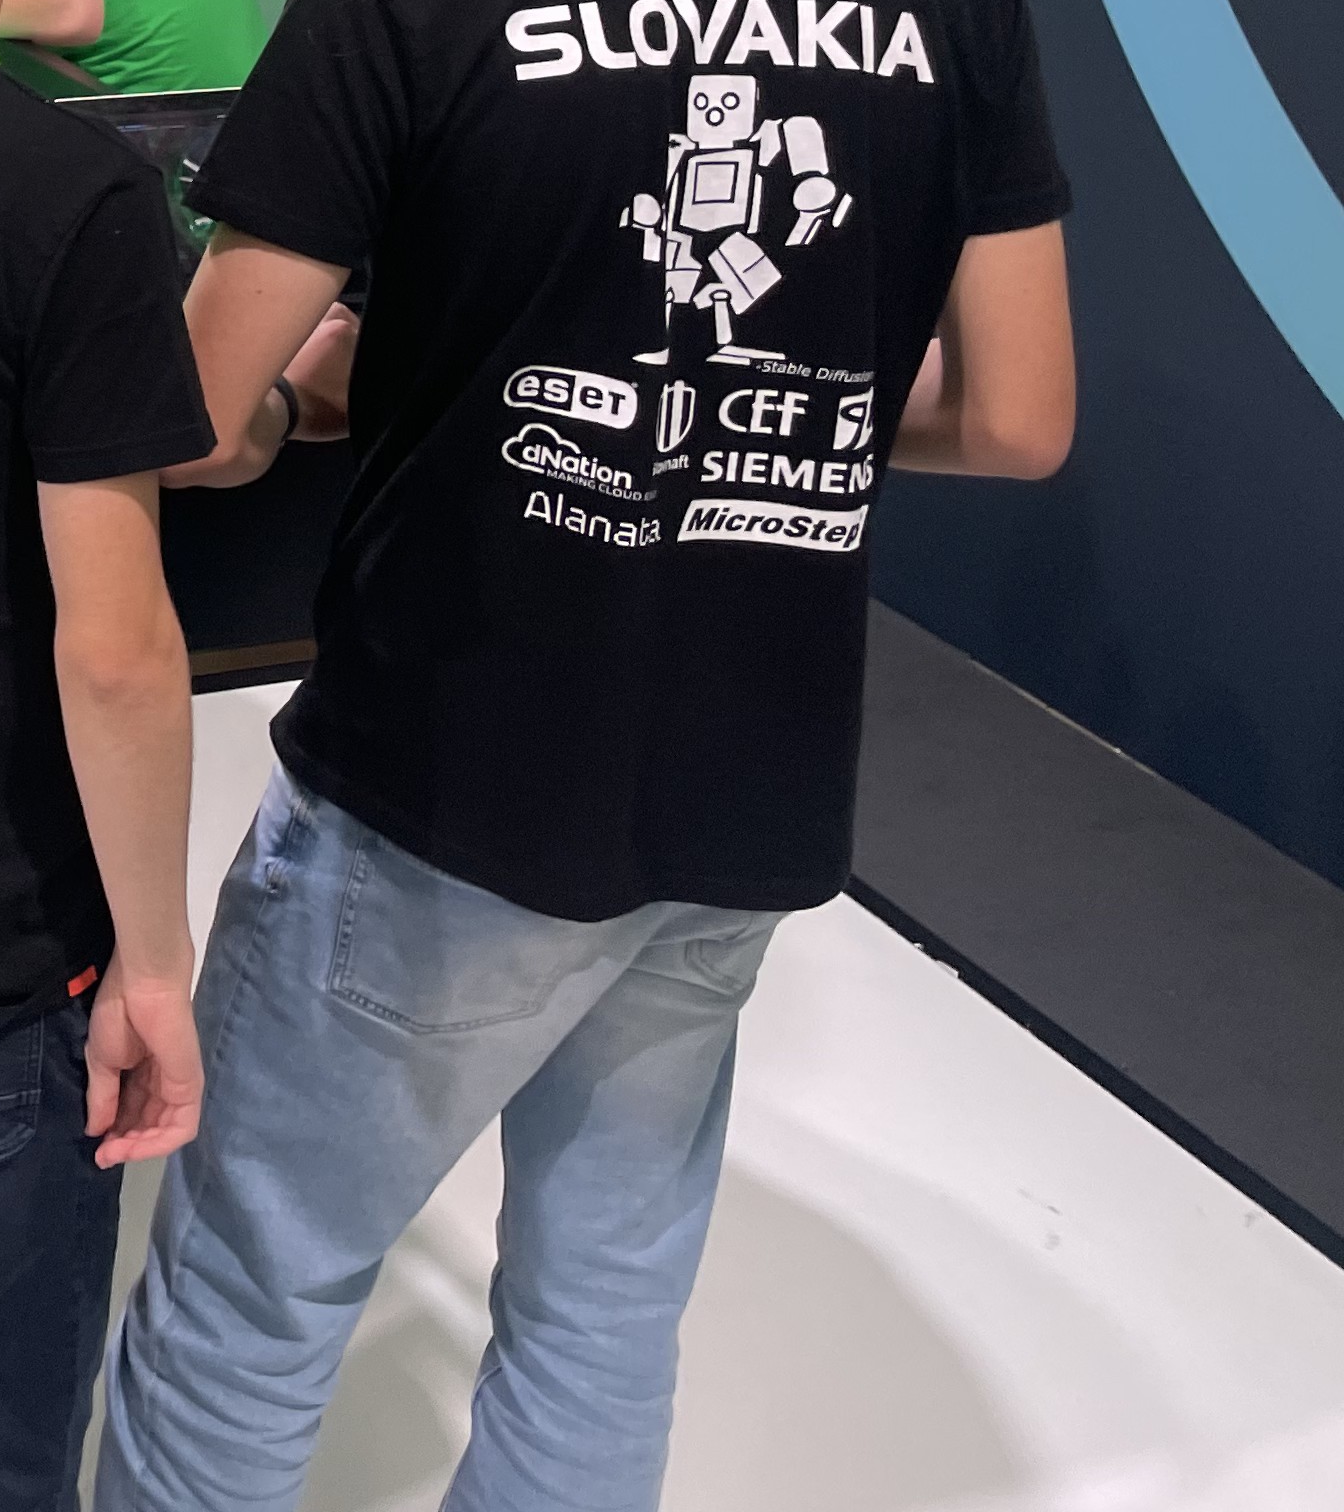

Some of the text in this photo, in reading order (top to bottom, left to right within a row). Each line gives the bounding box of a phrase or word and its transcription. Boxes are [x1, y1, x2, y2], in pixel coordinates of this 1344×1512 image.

[522, 444, 632, 490] dNation
[546, 468, 597, 490] MAKING
[598, 483, 643, 502] CLOUD
[700, 451, 874, 494] SIEMENS
[524, 490, 662, 547] Alanata
[685, 507, 860, 549] MicroStep
